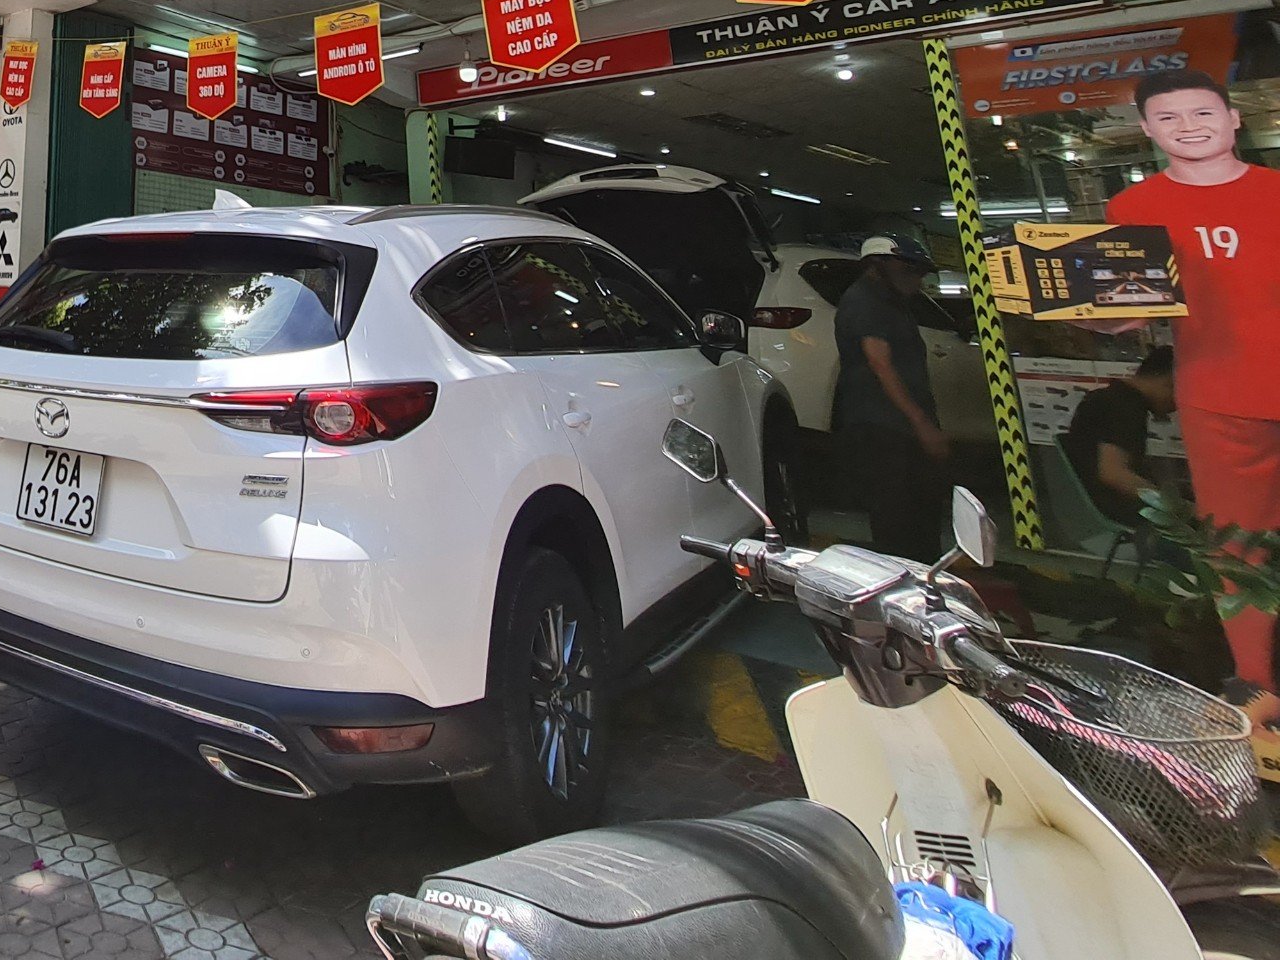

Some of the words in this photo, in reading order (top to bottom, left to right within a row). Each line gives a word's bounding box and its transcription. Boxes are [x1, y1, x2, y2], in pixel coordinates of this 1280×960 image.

[506, 16, 534, 35] NỆM
[535, 11, 554, 28] DA
[696, 13, 799, 44] THUẬN
[810, 5, 830, 23] Ý
[792, 30, 838, 45] HÀNG
[843, 17, 916, 37] PIONEER
[921, 7, 979, 24] CHÍNH
[328, 46, 347, 61] MÀN
[348, 43, 367, 57] HÌNH
[507, 38, 532, 57] CAO
[534, 30, 558, 50] CẤP
[196, 65, 228, 80] CAMERA
[323, 63, 357, 80] ANDROID
[358, 59, 364, 74] Ô
[365, 58, 376, 72] TÔ
[471, 55, 611, 90] Pioneer
[198, 84, 213, 98] 360
[214, 81, 226, 99] ĐỘ
[1038, 229, 1070, 238] Zestech
[1193, 225, 1239, 259] 19
[40, 449, 81, 490] 76A
[23, 482, 94, 530] 131.23
[239, 488, 288, 499] DELUXE
[423, 888, 514, 924] HONDA
